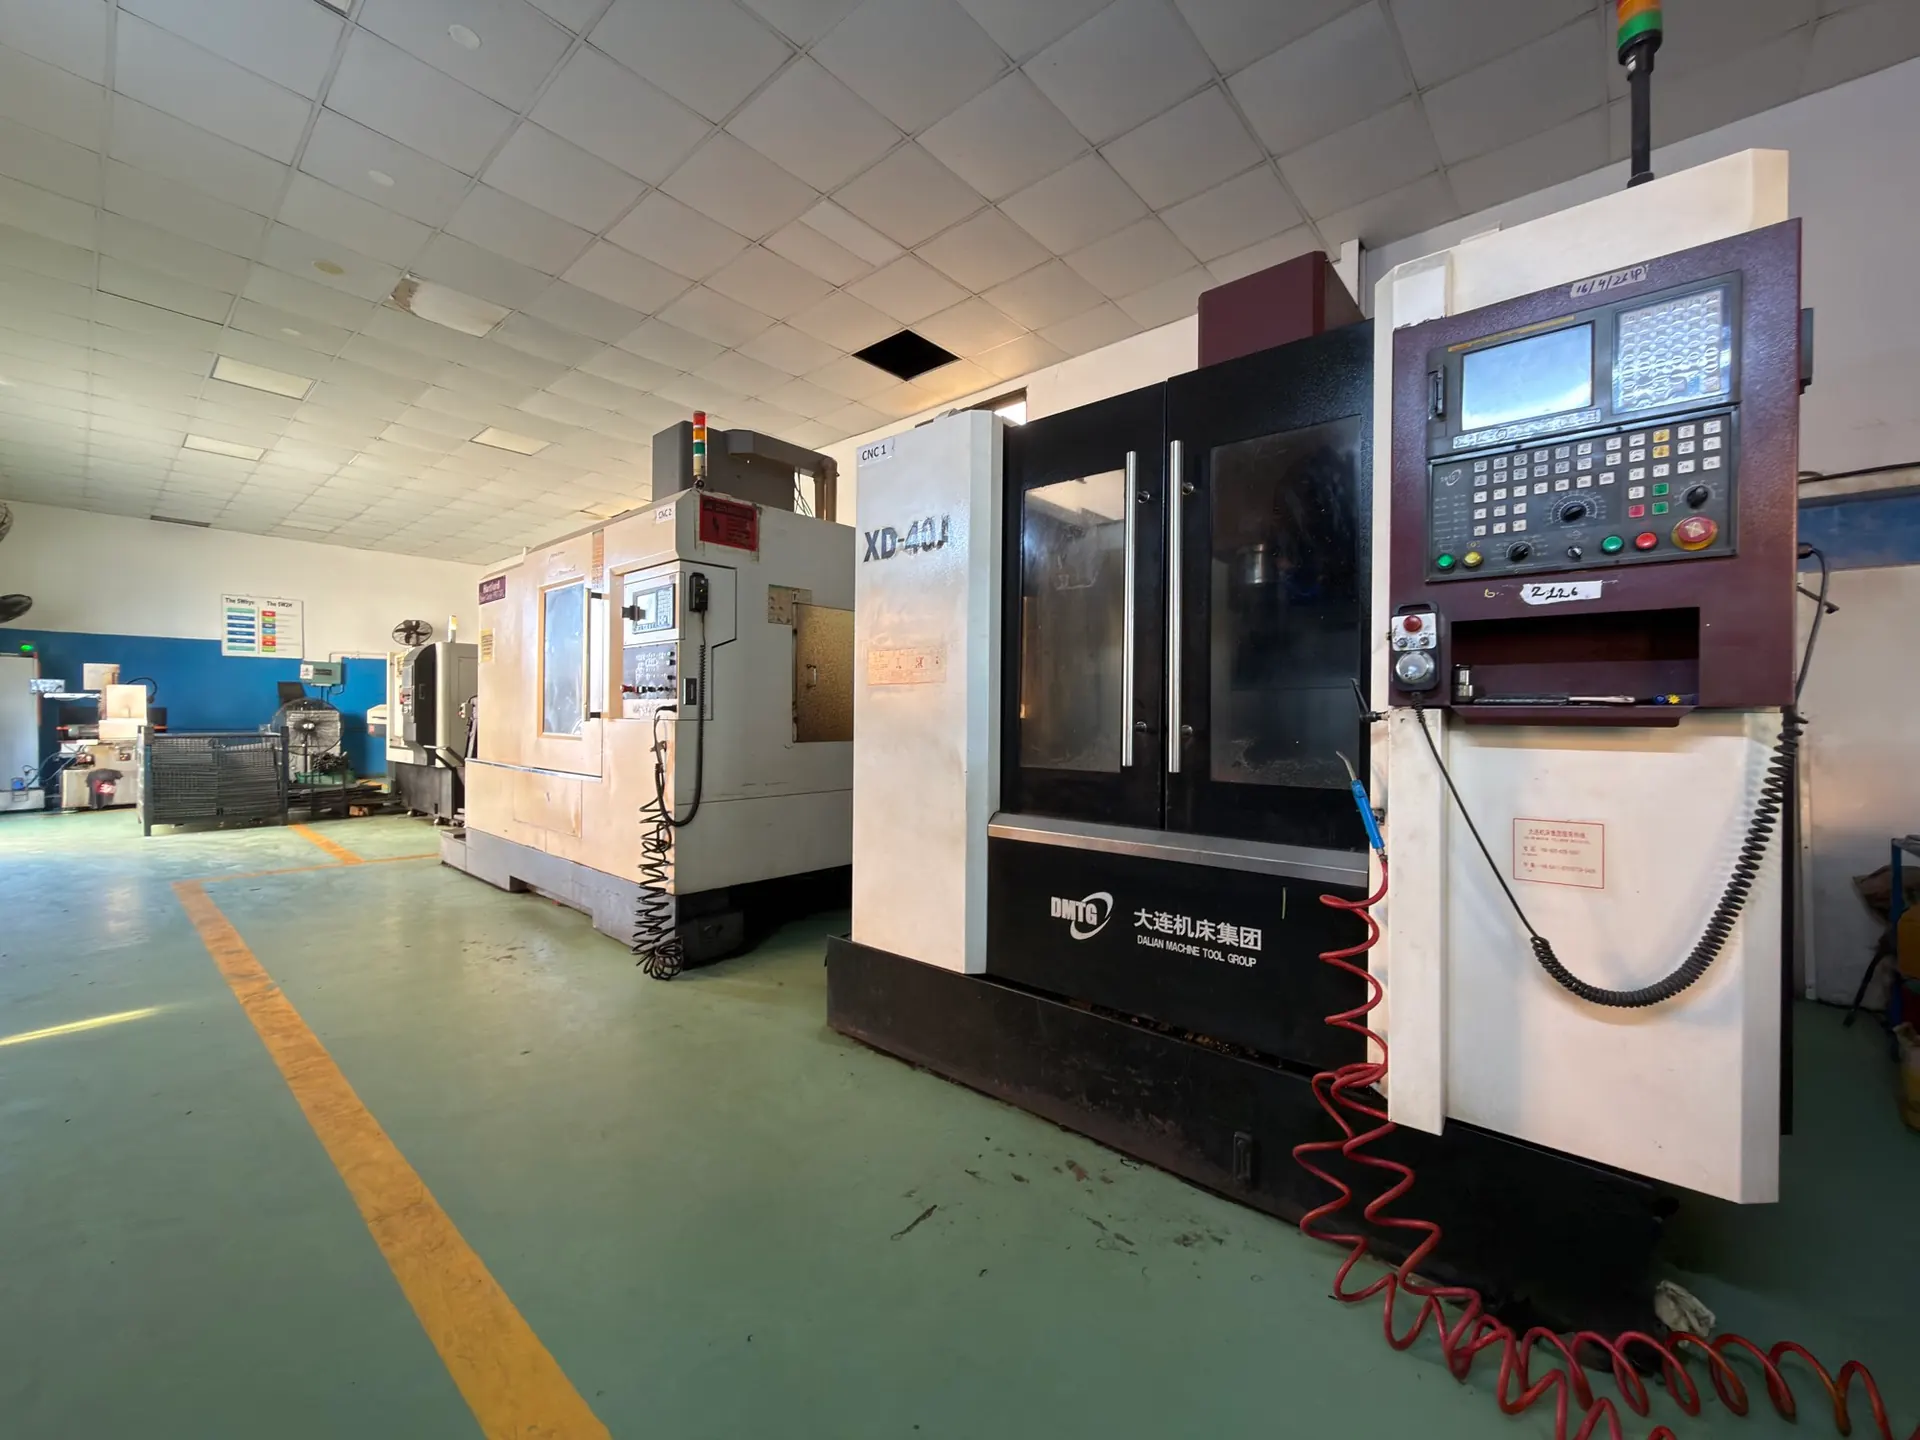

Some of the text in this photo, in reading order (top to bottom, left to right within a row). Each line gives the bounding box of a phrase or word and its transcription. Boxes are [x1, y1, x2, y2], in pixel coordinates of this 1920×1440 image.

[862, 445, 887, 461] CNC 1
[863, 512, 951, 563] XD-40J
[266, 600, 277, 608] The
[1050, 896, 1098, 926] DMTG
[1133, 908, 1262, 951] 大连机床集团
[1137, 934, 1257, 968] DALIAN MACHINE TOOL GROUP
